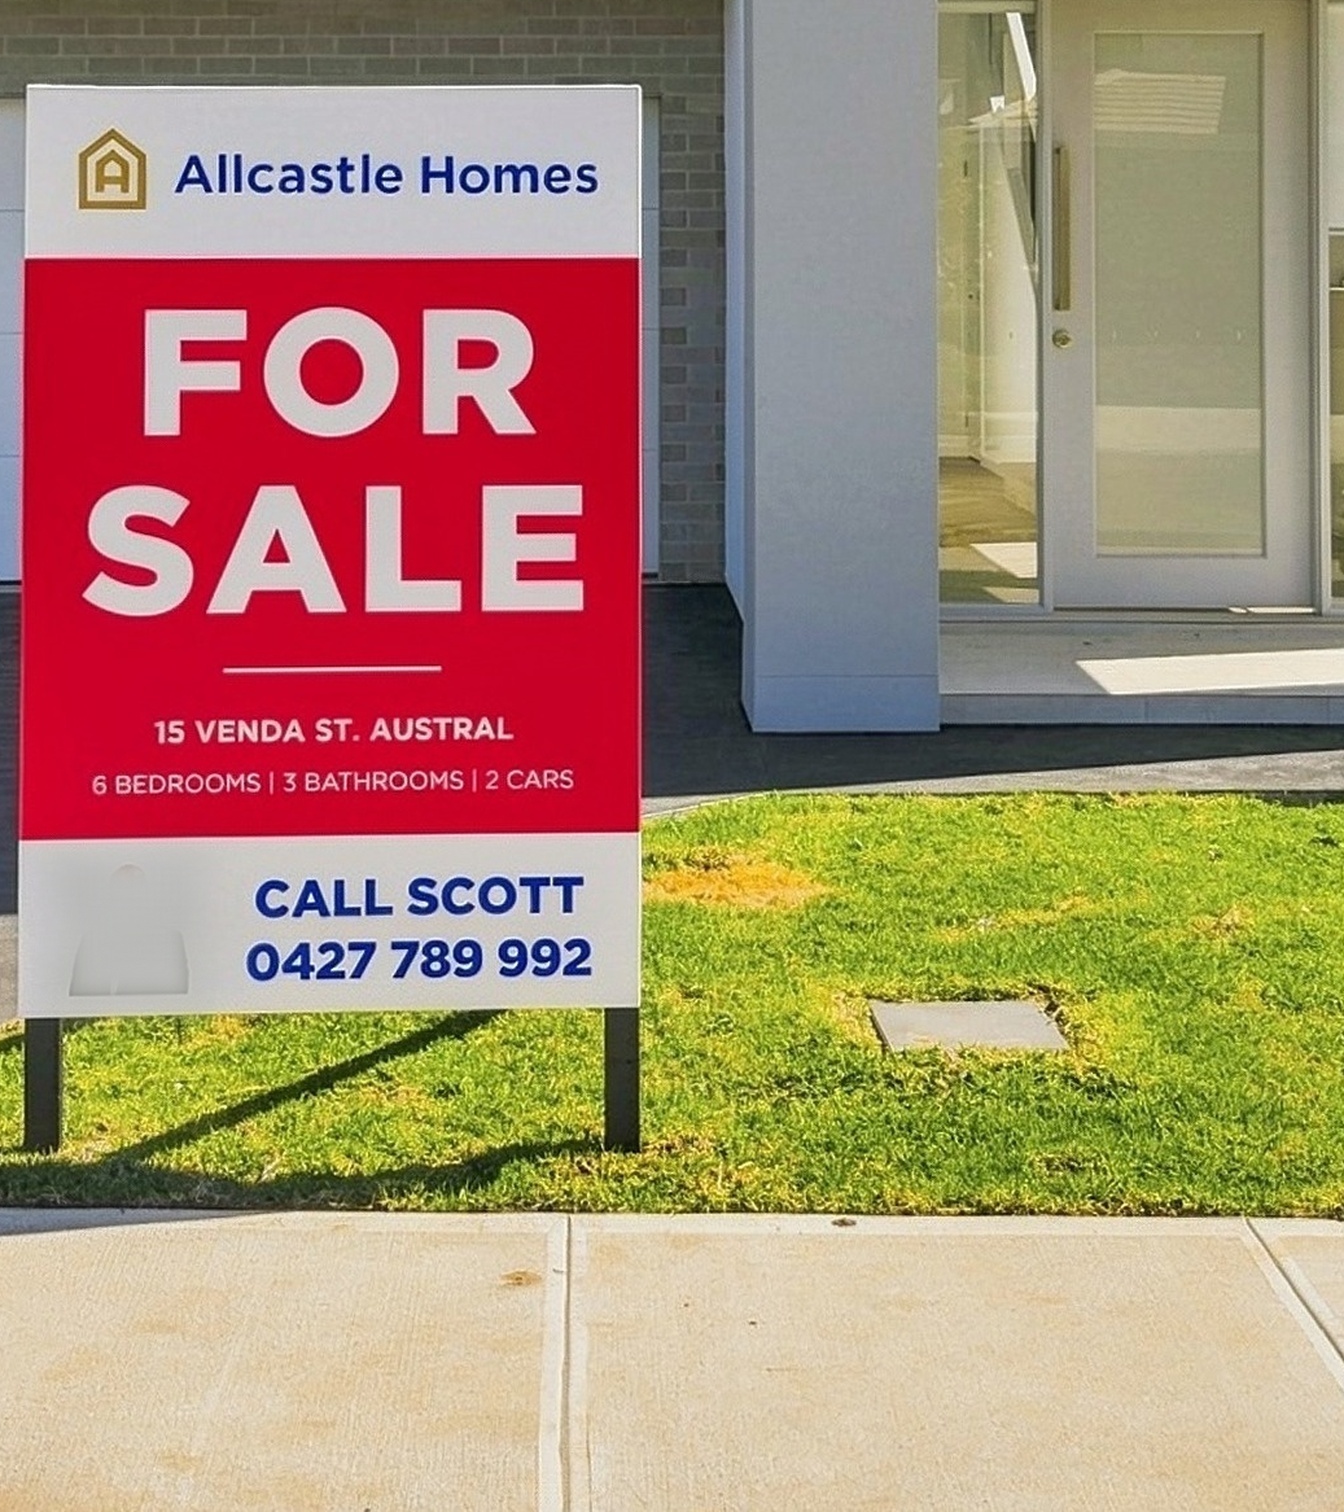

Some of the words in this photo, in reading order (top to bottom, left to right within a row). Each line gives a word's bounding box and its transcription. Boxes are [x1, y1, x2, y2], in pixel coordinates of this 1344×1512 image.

[174, 153, 404, 195] Allcastle
[421, 154, 599, 195] Homes
[143, 306, 538, 438] FOR
[82, 484, 584, 617] SALE
[154, 720, 185, 744] 15
[195, 719, 306, 743] VENDA
[315, 718, 359, 742] ST.
[370, 716, 514, 741] AUSTRAL
[91, 775, 107, 795] 6
[115, 772, 261, 795] BEDROOMS
[283, 772, 297, 792] 3
[304, 770, 464, 792] BATHROOMS
[485, 770, 499, 790] 2
[507, 769, 574, 789] CARS
[254, 878, 394, 919] CALL
[406, 875, 585, 916] SCOTT
[246, 941, 377, 982] 0427
[390, 939, 483, 979] 789
[497, 938, 592, 978] 992
